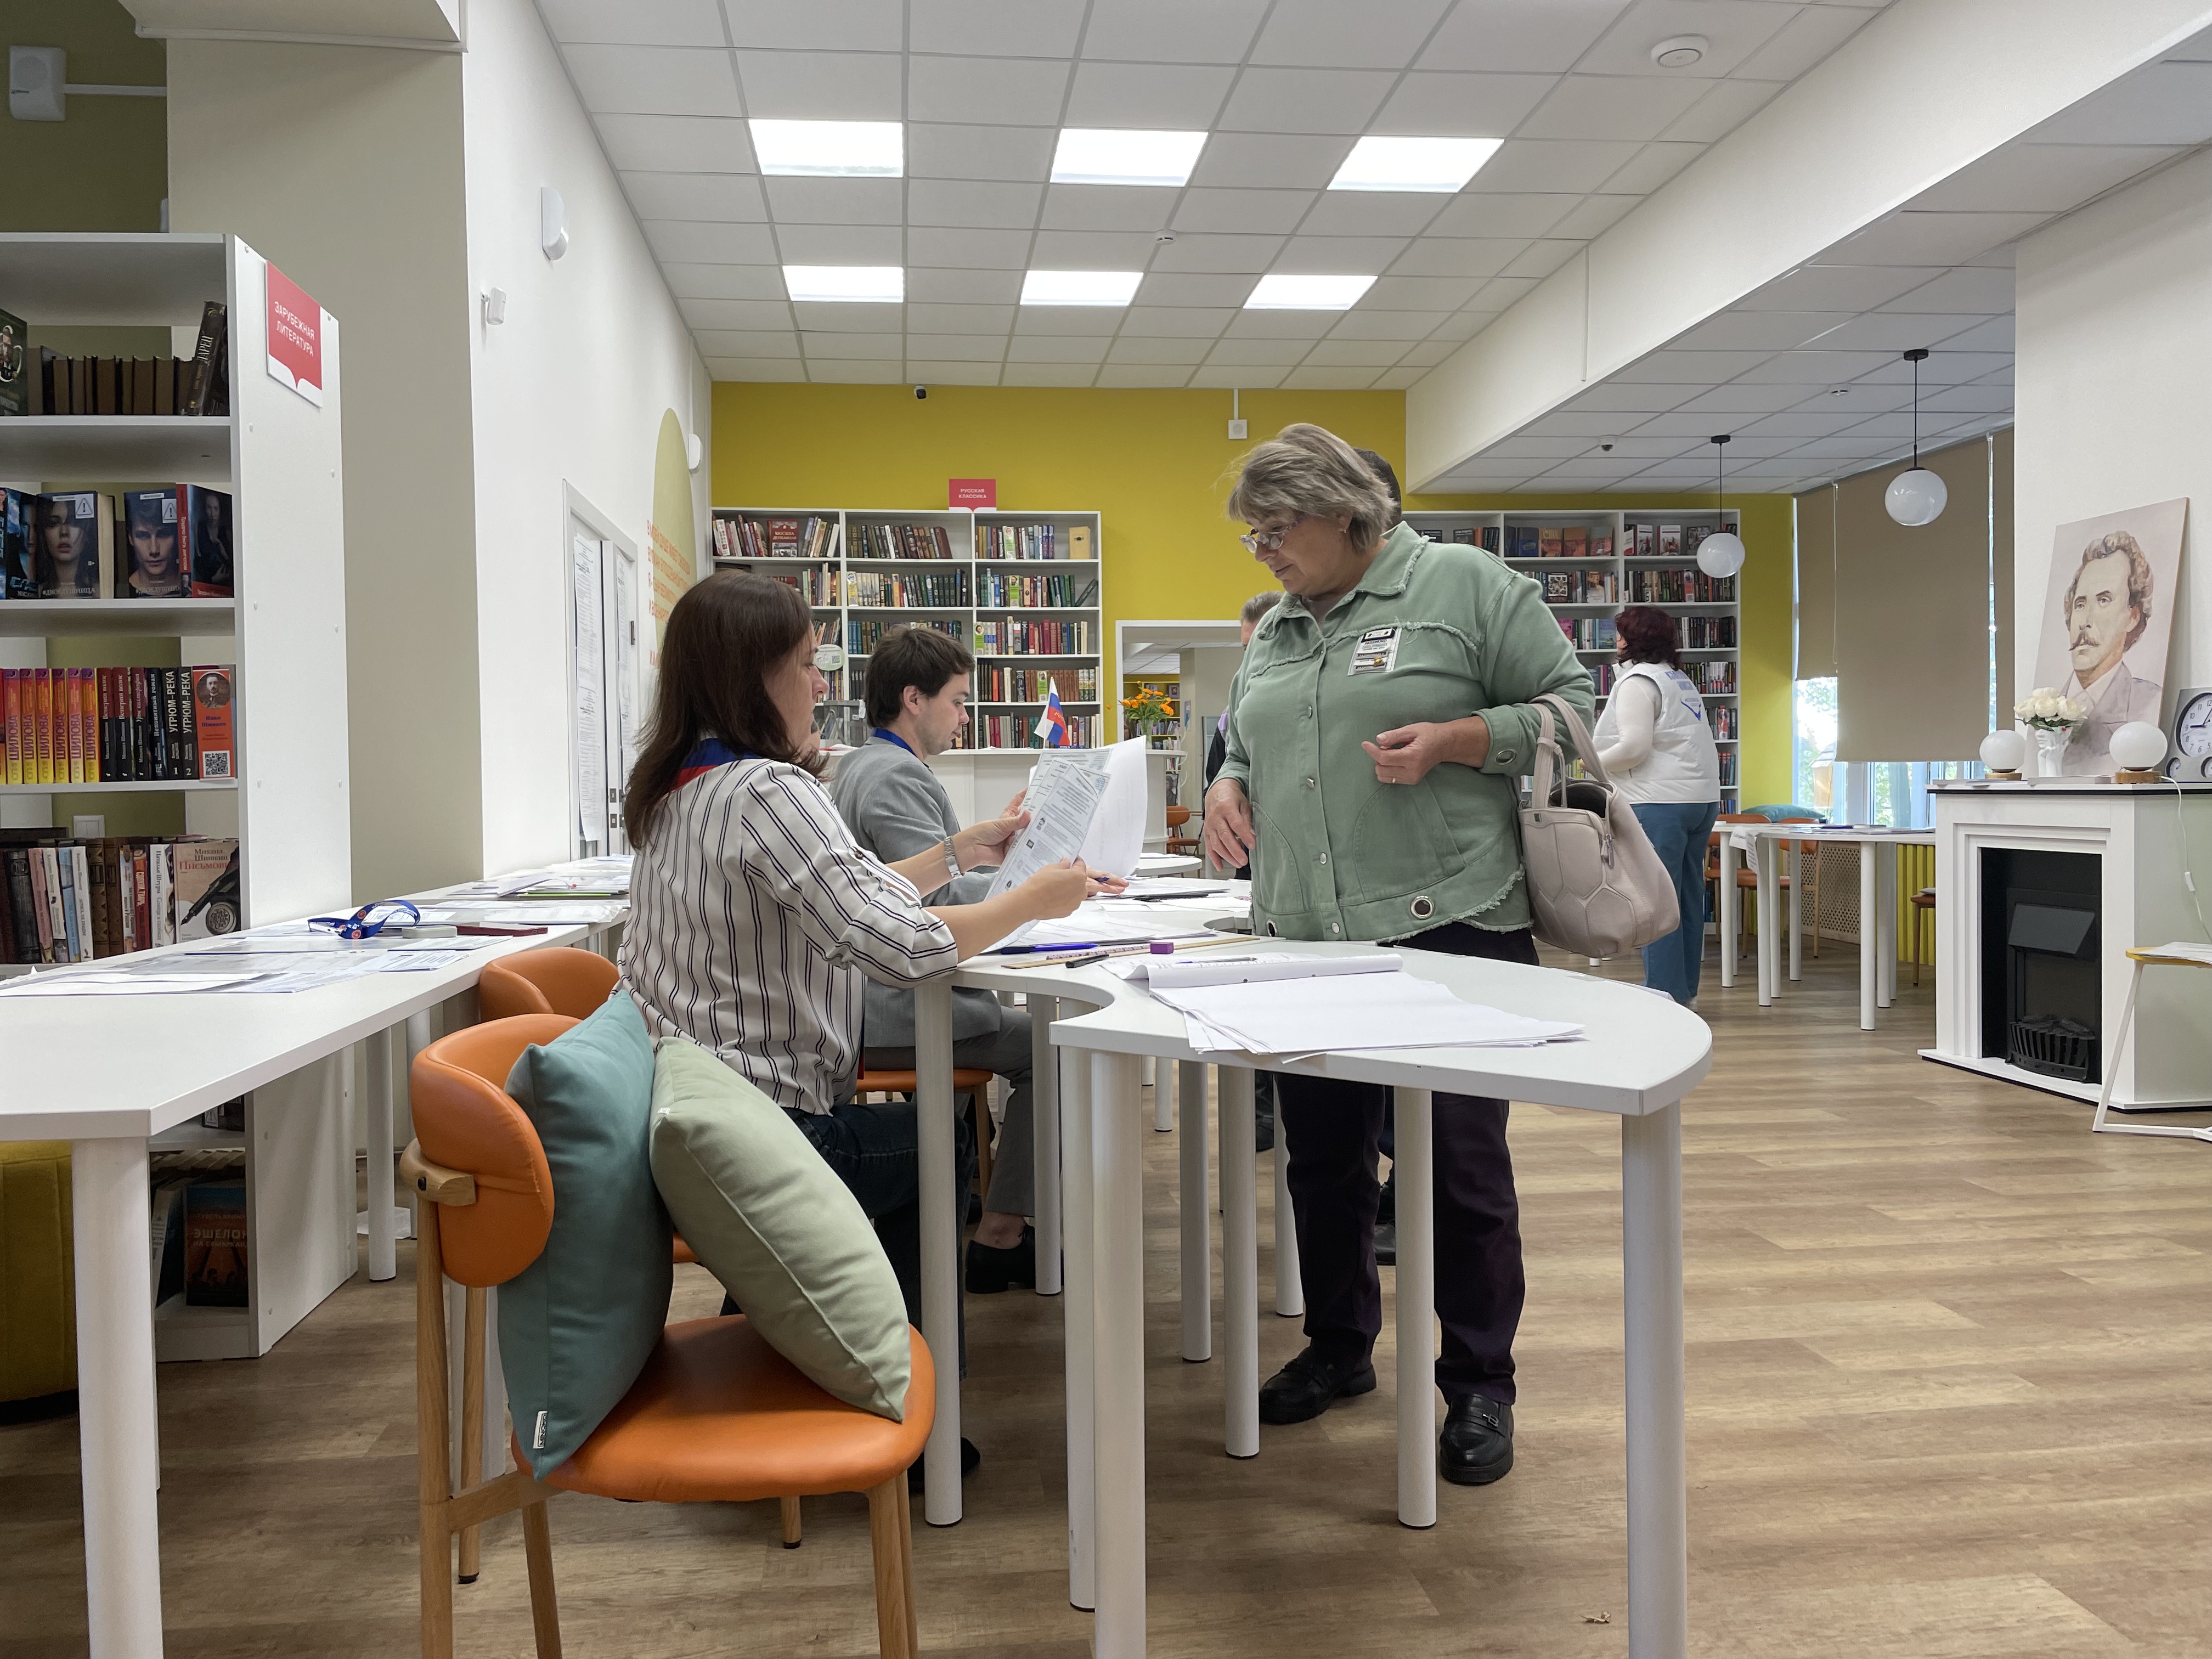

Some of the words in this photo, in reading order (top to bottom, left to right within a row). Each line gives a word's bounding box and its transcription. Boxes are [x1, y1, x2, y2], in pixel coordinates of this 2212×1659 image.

[275, 301, 314, 341] ЗАРУБЕЖНАЯ
[276, 320, 314, 357] ЛИТЕРАТУРА
[151, 695, 160, 737] Непонятный
[166, 671, 178, 732] УГРЮМ-РЕКА
[181, 672, 192, 734] УГРЮМ-РЕКА
[9, 714, 19, 760] ШИЛОВА
[23, 714, 35, 760] ШИЛОВА
[40, 714, 50, 759] ШИЛОВА
[56, 714, 66, 759] ШИЛОВА
[71, 714, 82, 759] ШИЛОВА
[85, 715, 97, 760] ШИЛОВА
